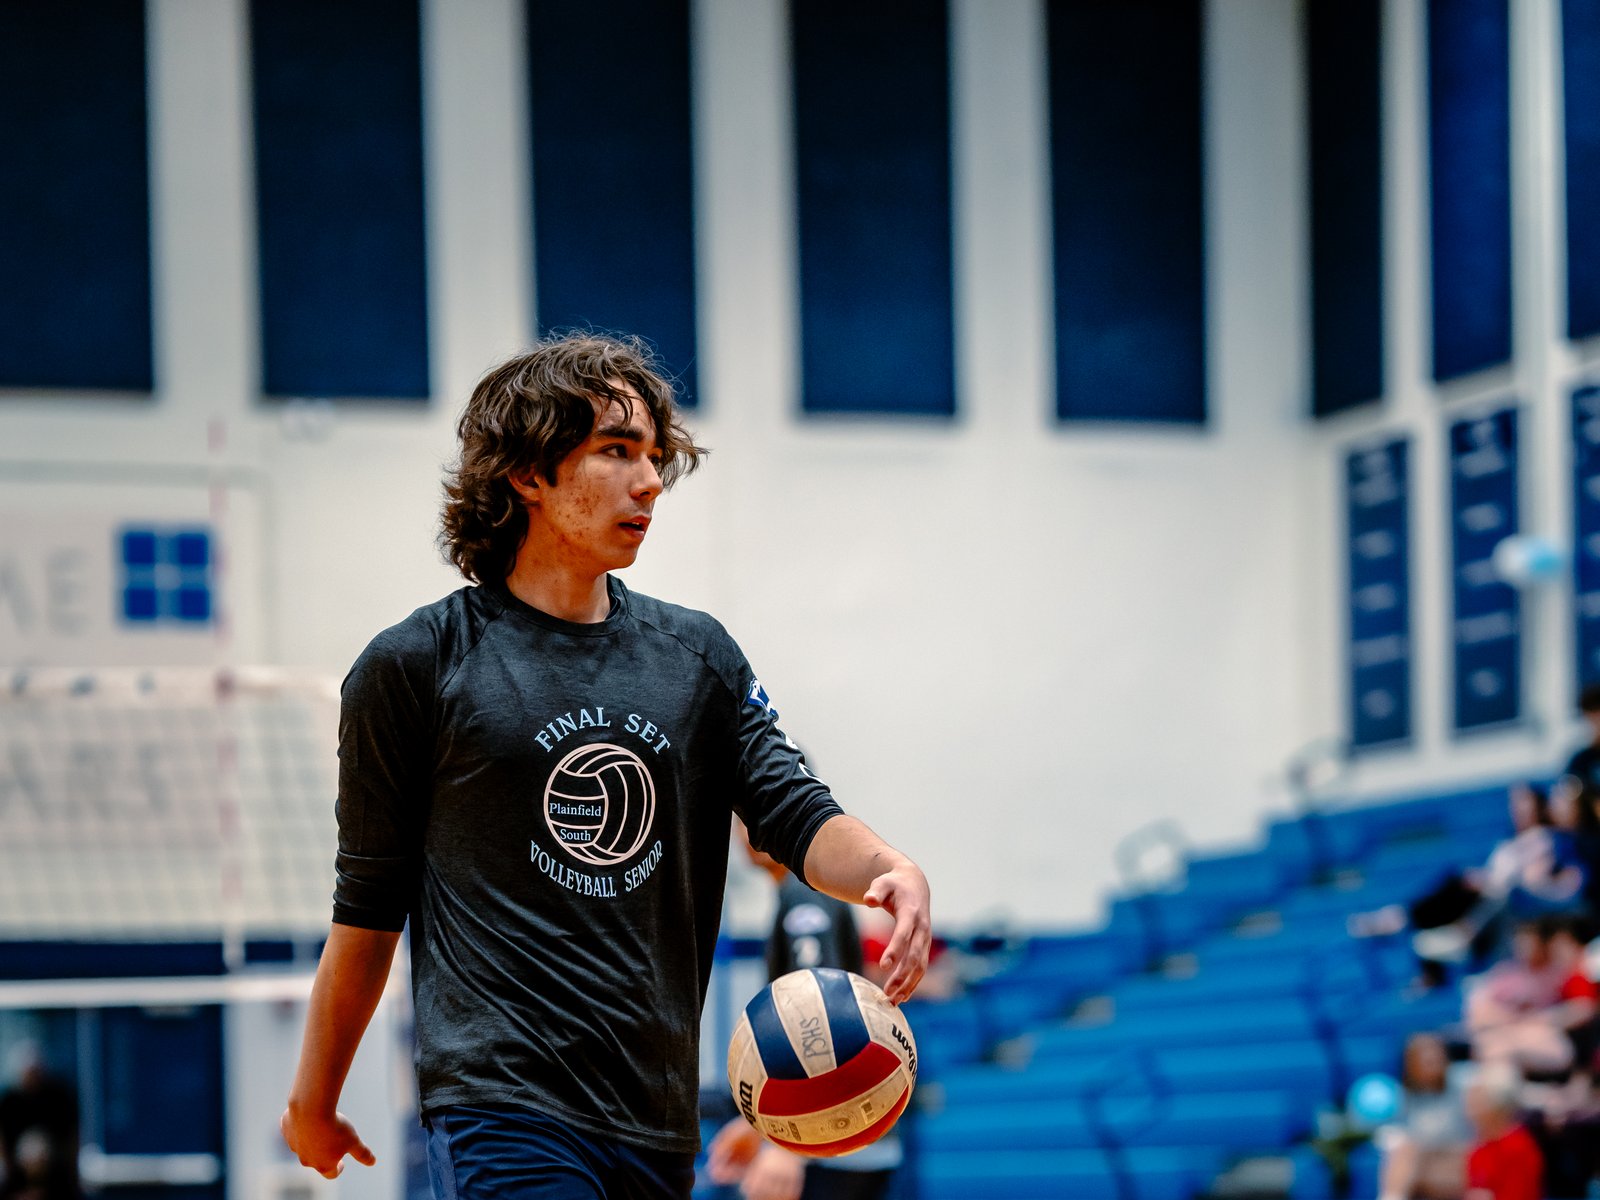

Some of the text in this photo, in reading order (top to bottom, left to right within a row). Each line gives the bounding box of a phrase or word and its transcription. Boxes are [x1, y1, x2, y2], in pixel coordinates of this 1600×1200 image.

[534, 706, 671, 754] FINAL SET
[549, 802, 602, 817] Plainfield
[560, 828, 592, 842] South
[530, 839, 663, 898] VOLLEYBALL SENIOR
[799, 1016, 833, 1058] PSHS
